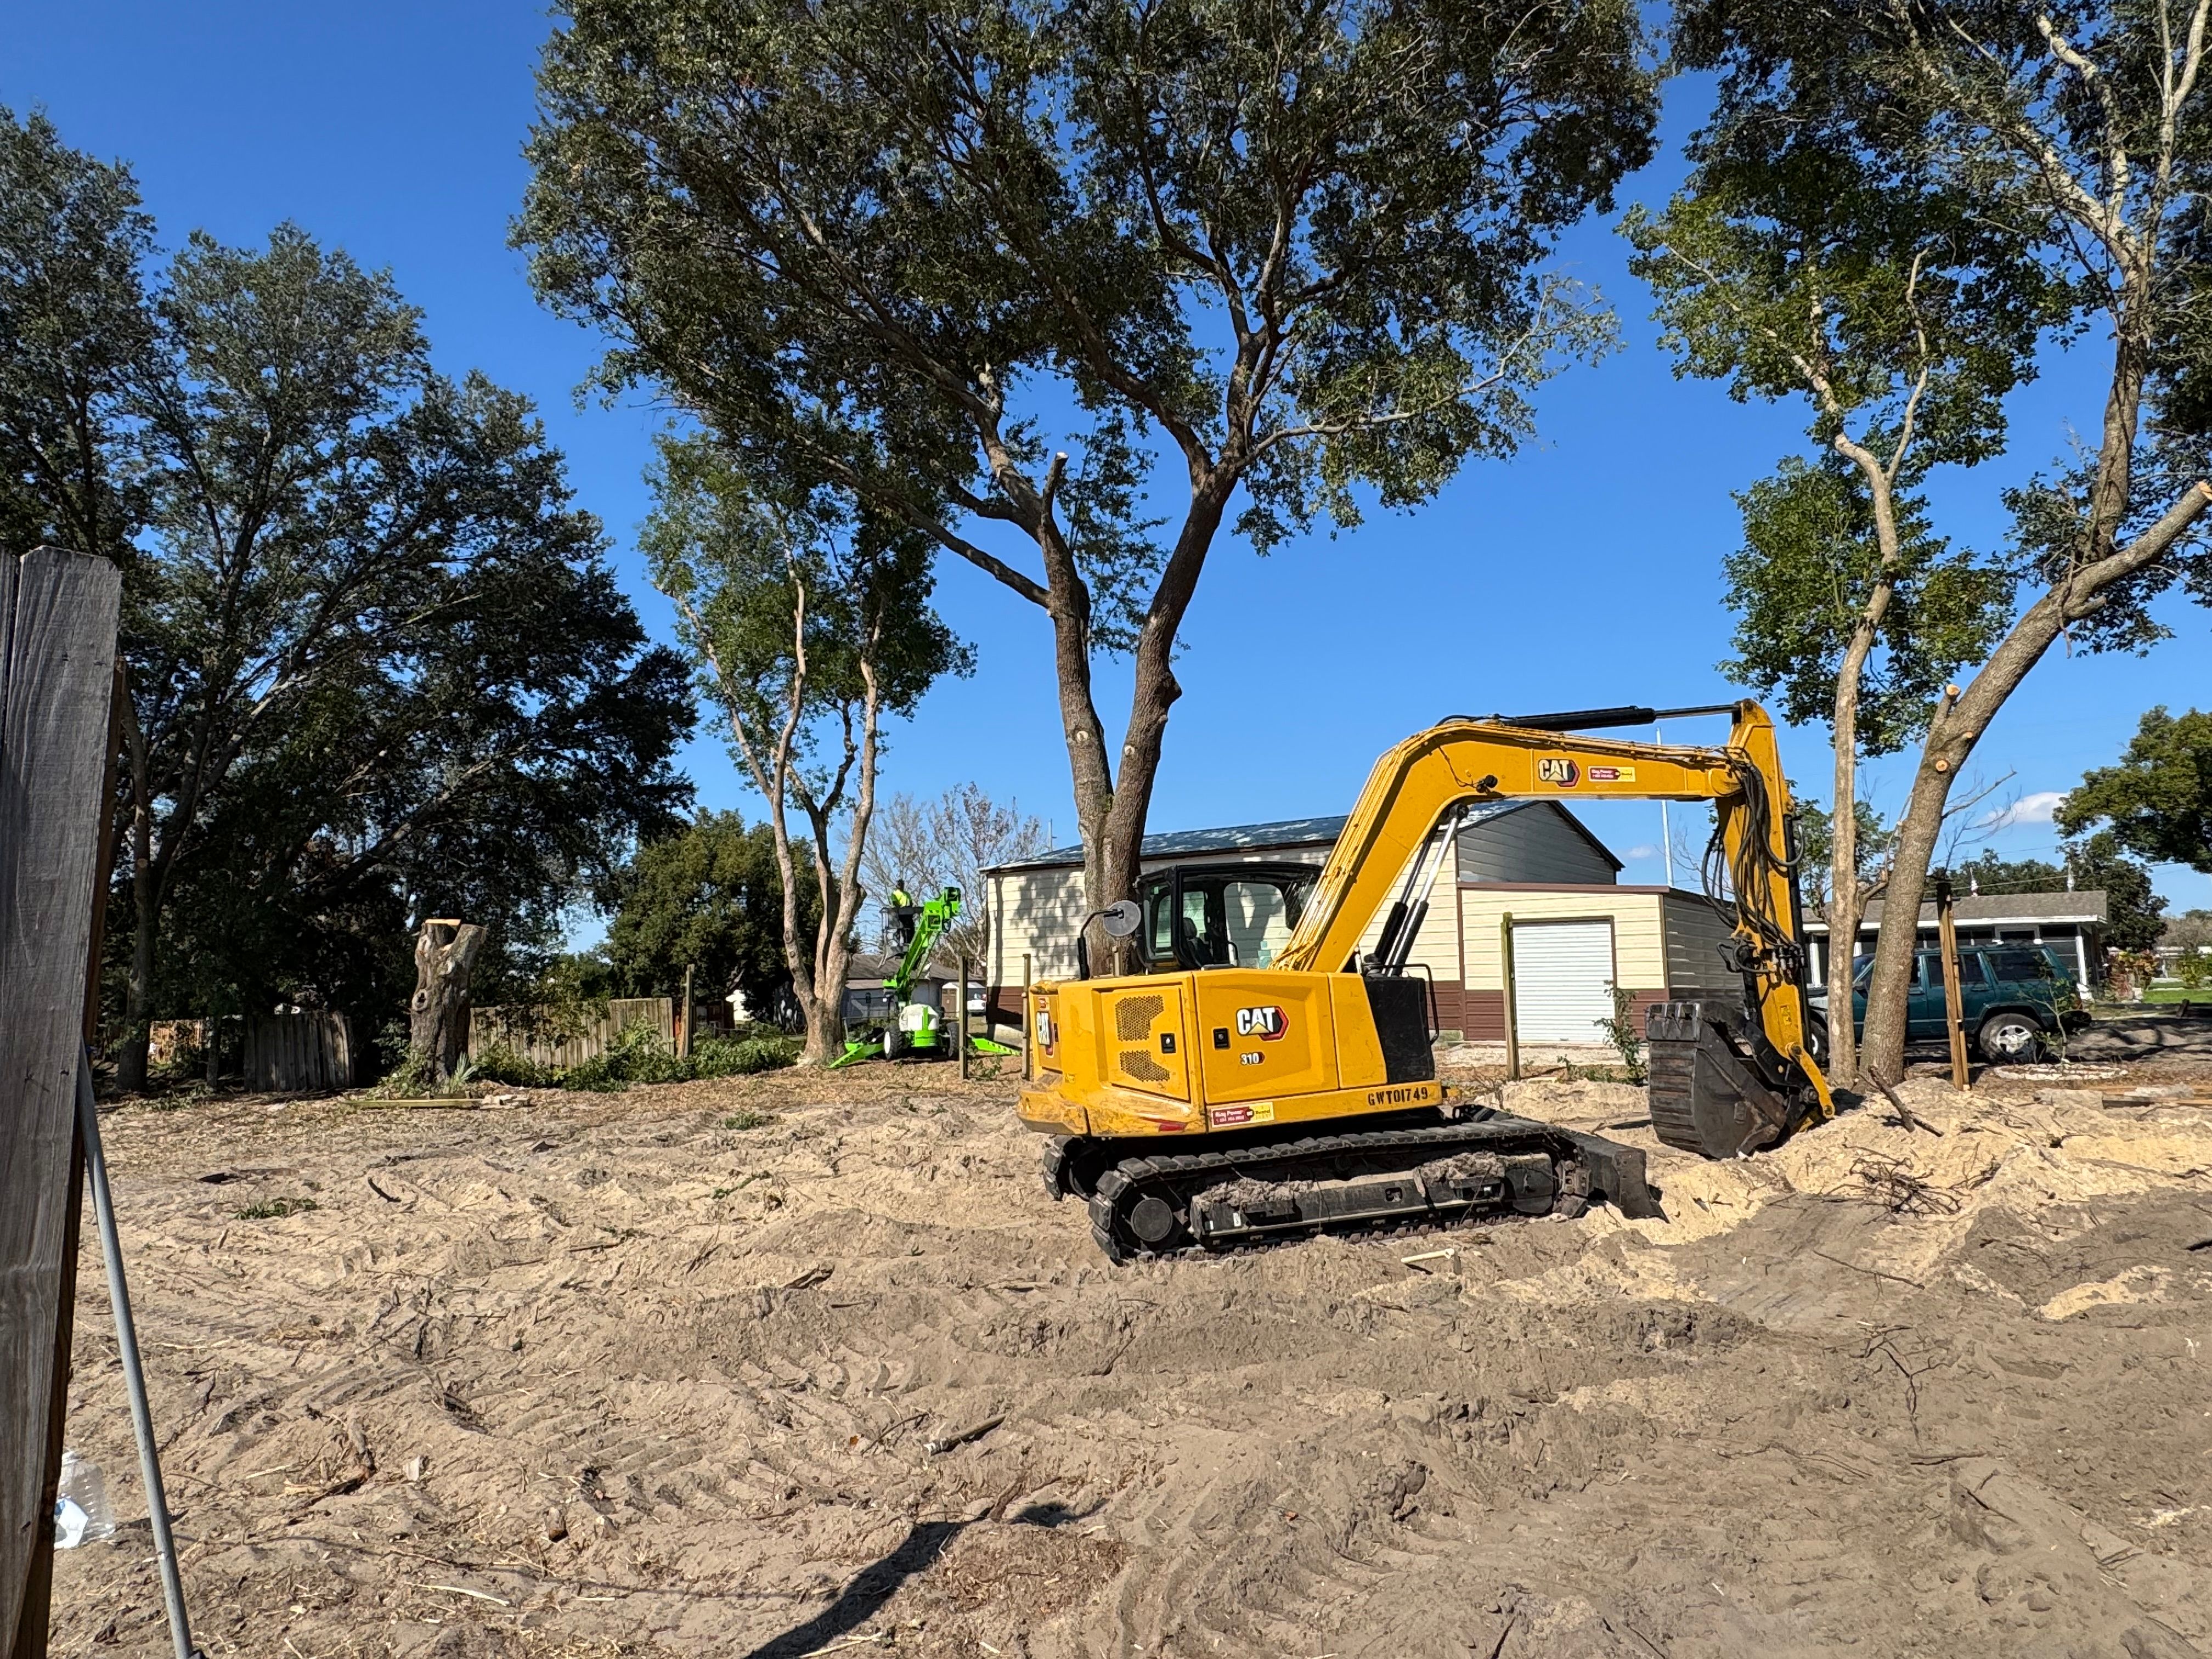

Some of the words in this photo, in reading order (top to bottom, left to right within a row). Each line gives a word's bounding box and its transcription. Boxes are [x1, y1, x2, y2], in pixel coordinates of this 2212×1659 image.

[1538, 759, 1569, 780] CAT
[1037, 1012, 1049, 1045] CAT
[1237, 1007, 1276, 1035] CAT
[1241, 1052, 1260, 1064] 310
